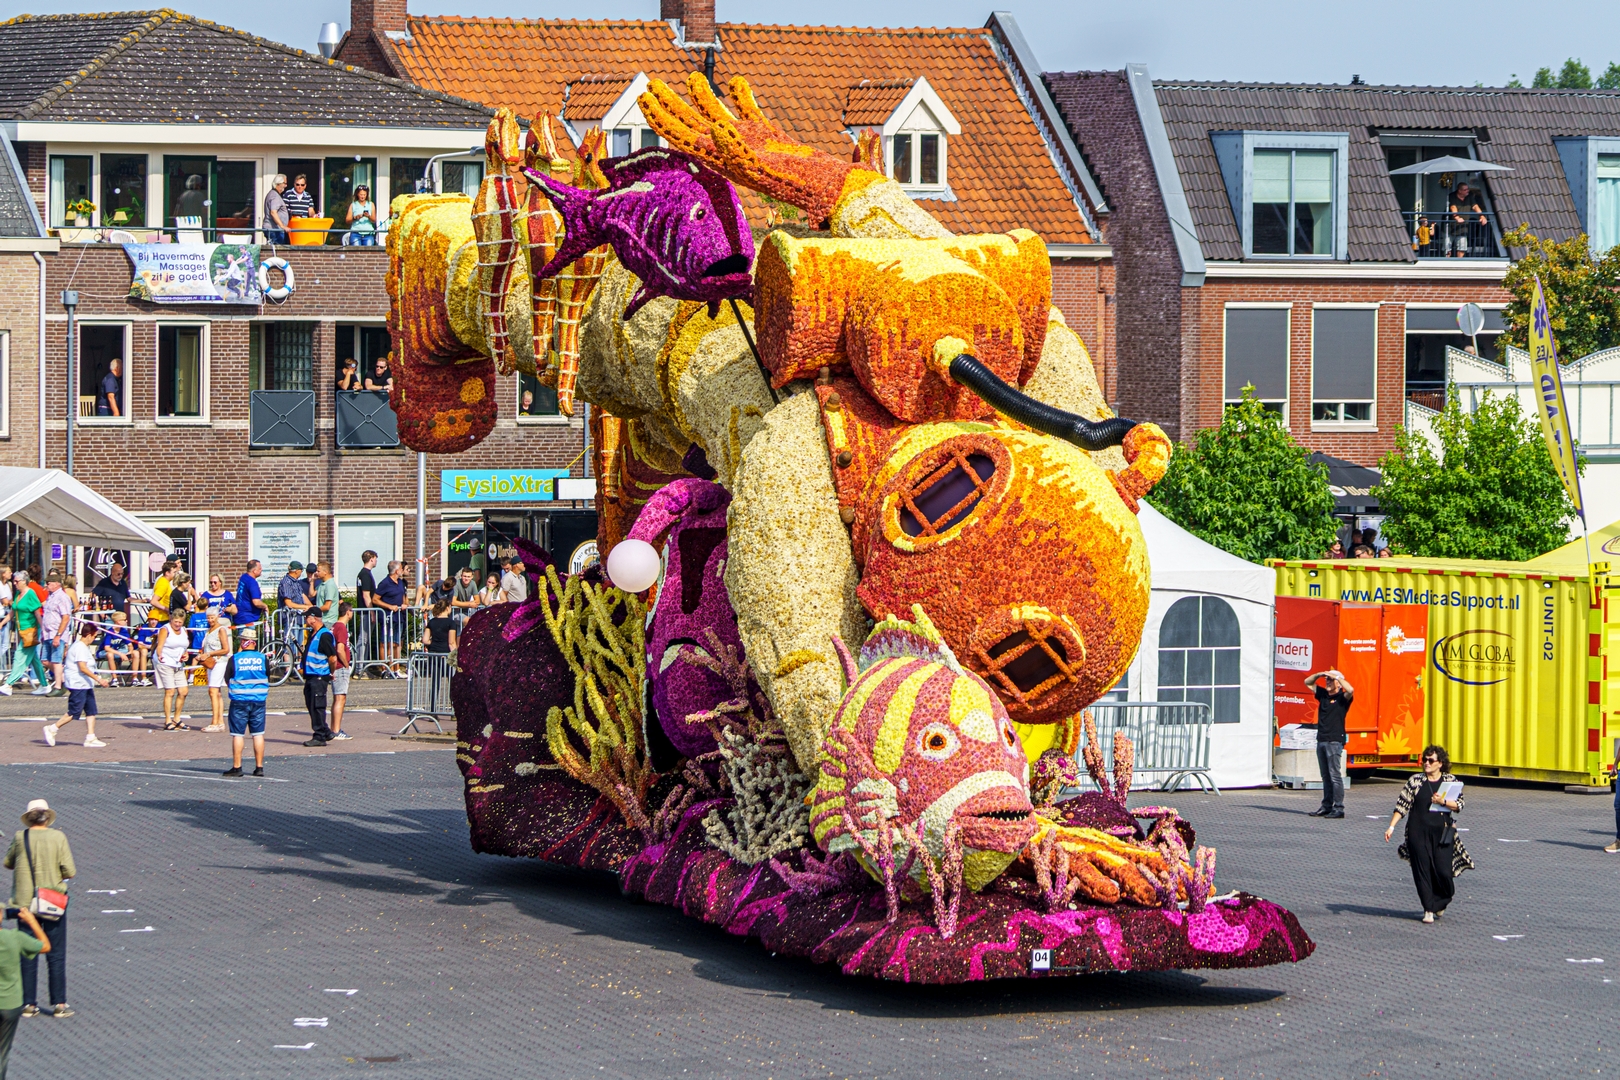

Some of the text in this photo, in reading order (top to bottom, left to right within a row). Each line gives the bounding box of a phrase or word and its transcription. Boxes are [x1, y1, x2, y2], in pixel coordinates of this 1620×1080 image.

[138, 252, 205, 262] Bij Havermans
[159, 262, 207, 272] Massages
[151, 272, 208, 283] zit je goed!
[455, 474, 554, 498] FysioXtra
[224, 531, 235, 539] 210
[1544, 595, 1554, 661] UNIT-02
[1469, 644, 1516, 663] GLOBAL
[238, 657, 263, 665] corso
[238, 664, 263, 672] zundert
[1034, 951, 1049, 962] 04
